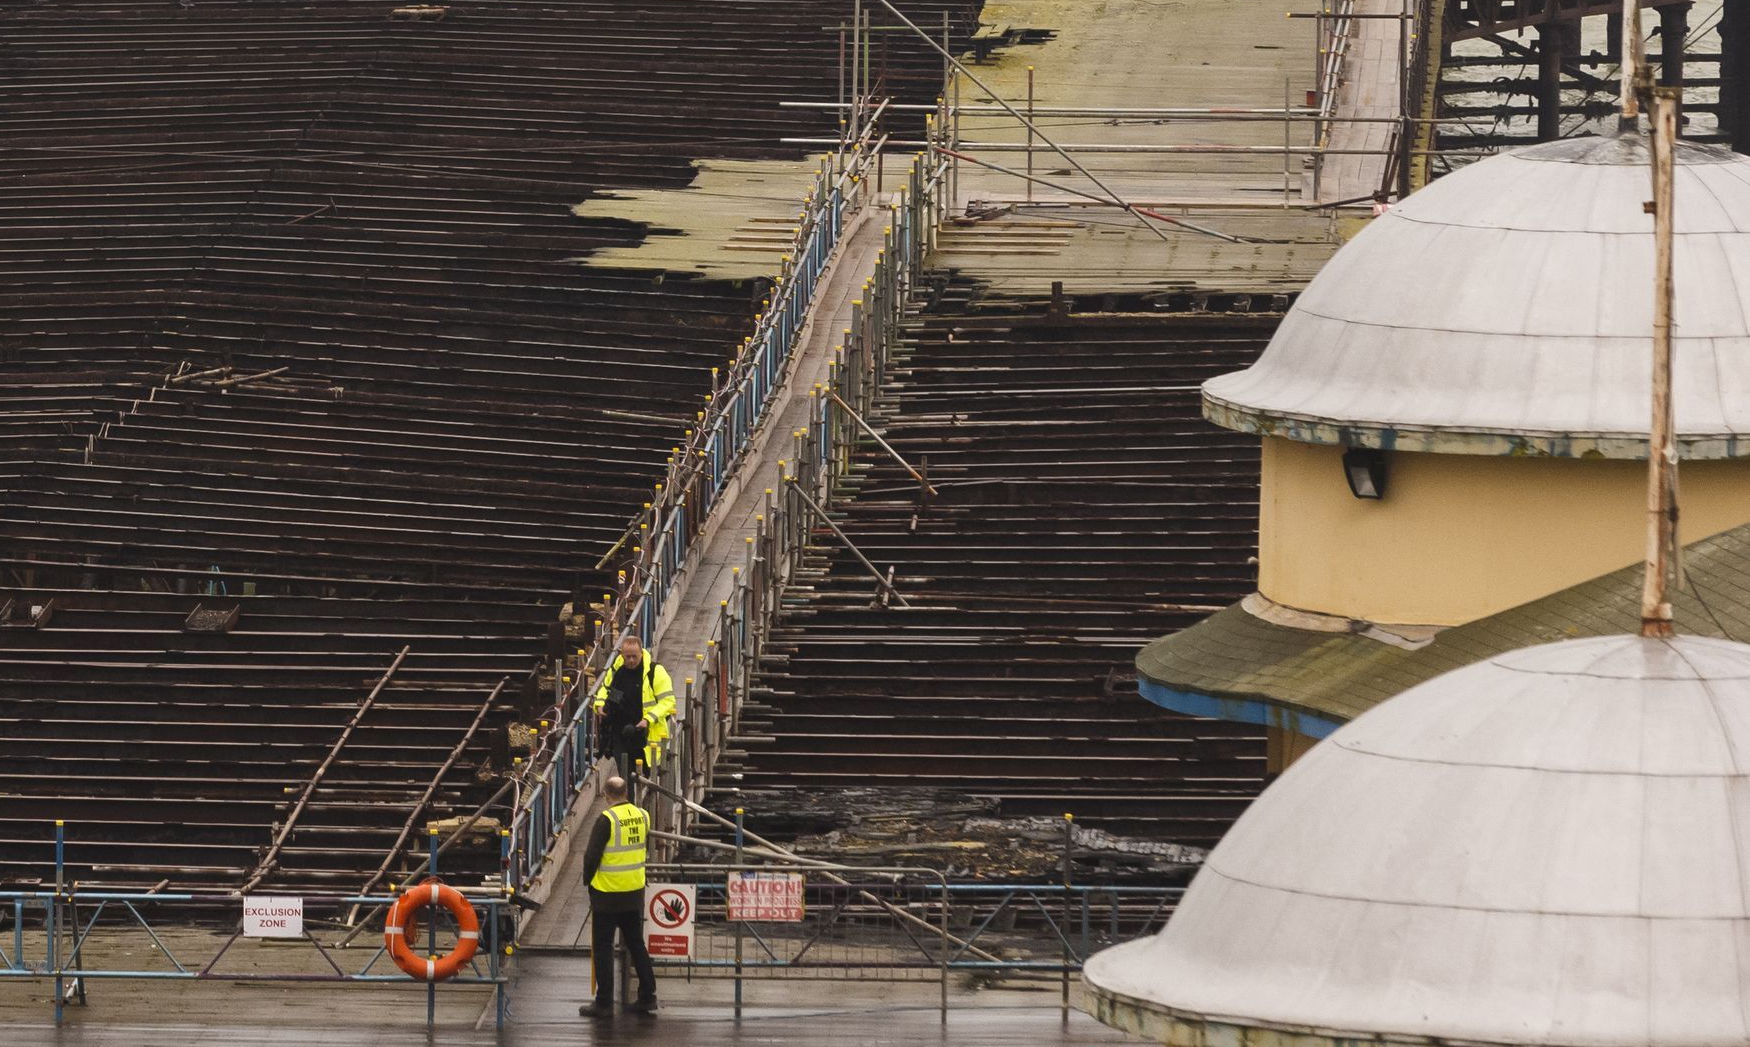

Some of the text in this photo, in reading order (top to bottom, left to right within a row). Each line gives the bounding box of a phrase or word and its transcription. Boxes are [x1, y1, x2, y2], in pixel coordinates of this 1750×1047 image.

[619, 817, 644, 827] SUPPORT
[629, 827, 639, 835] THE
[628, 836, 640, 845] PIER
[730, 880, 801, 894] CAUTION!
[245, 908, 301, 917] EXCLUSION
[733, 908, 798, 918] KEEP OUT
[259, 920, 286, 928] ZONE
